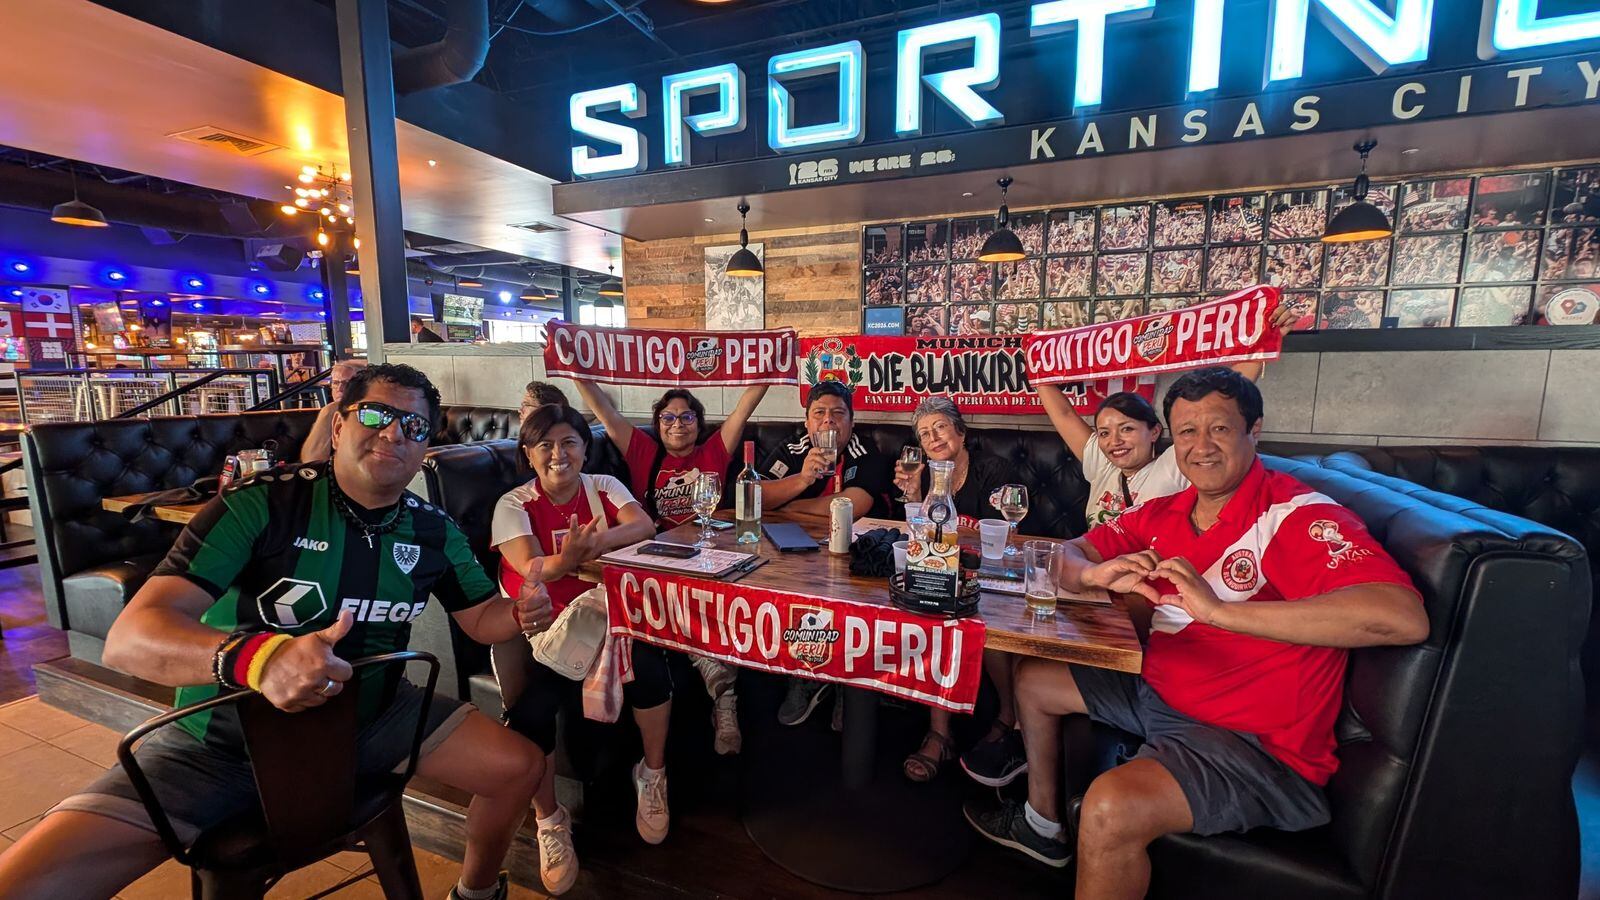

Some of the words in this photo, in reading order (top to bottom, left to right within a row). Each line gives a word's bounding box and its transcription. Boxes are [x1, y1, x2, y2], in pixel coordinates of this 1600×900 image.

[1030, 95, 1321, 160] KANSAS
[1392, 59, 1600, 119] CITY
[797, 158, 839, 179] 26
[848, 159, 875, 175] WE
[876, 154, 911, 171] ARE
[798, 176, 823, 184] KANSAS
[1176, 290, 1267, 355] PERÚ
[554, 327, 685, 375] CONTIGO
[725, 332, 793, 375] PERÚ
[916, 337, 1022, 350] MUNICH
[1027, 323, 1133, 374] CONTIGO
[868, 351, 905, 393] DIE
[864, 395, 884, 404] FAN
[885, 395, 912, 404] CLUB
[957, 396, 1009, 406] PERUANA
[1011, 396, 1026, 406] DE
[293, 536, 329, 552] JAKO
[337, 598, 426, 623] FIEGE
[619, 571, 782, 660] CONTIGO
[782, 629, 840, 643] COMUNIDAD
[796, 640, 827, 657] PERÚ
[844, 615, 964, 689] PERÚ
